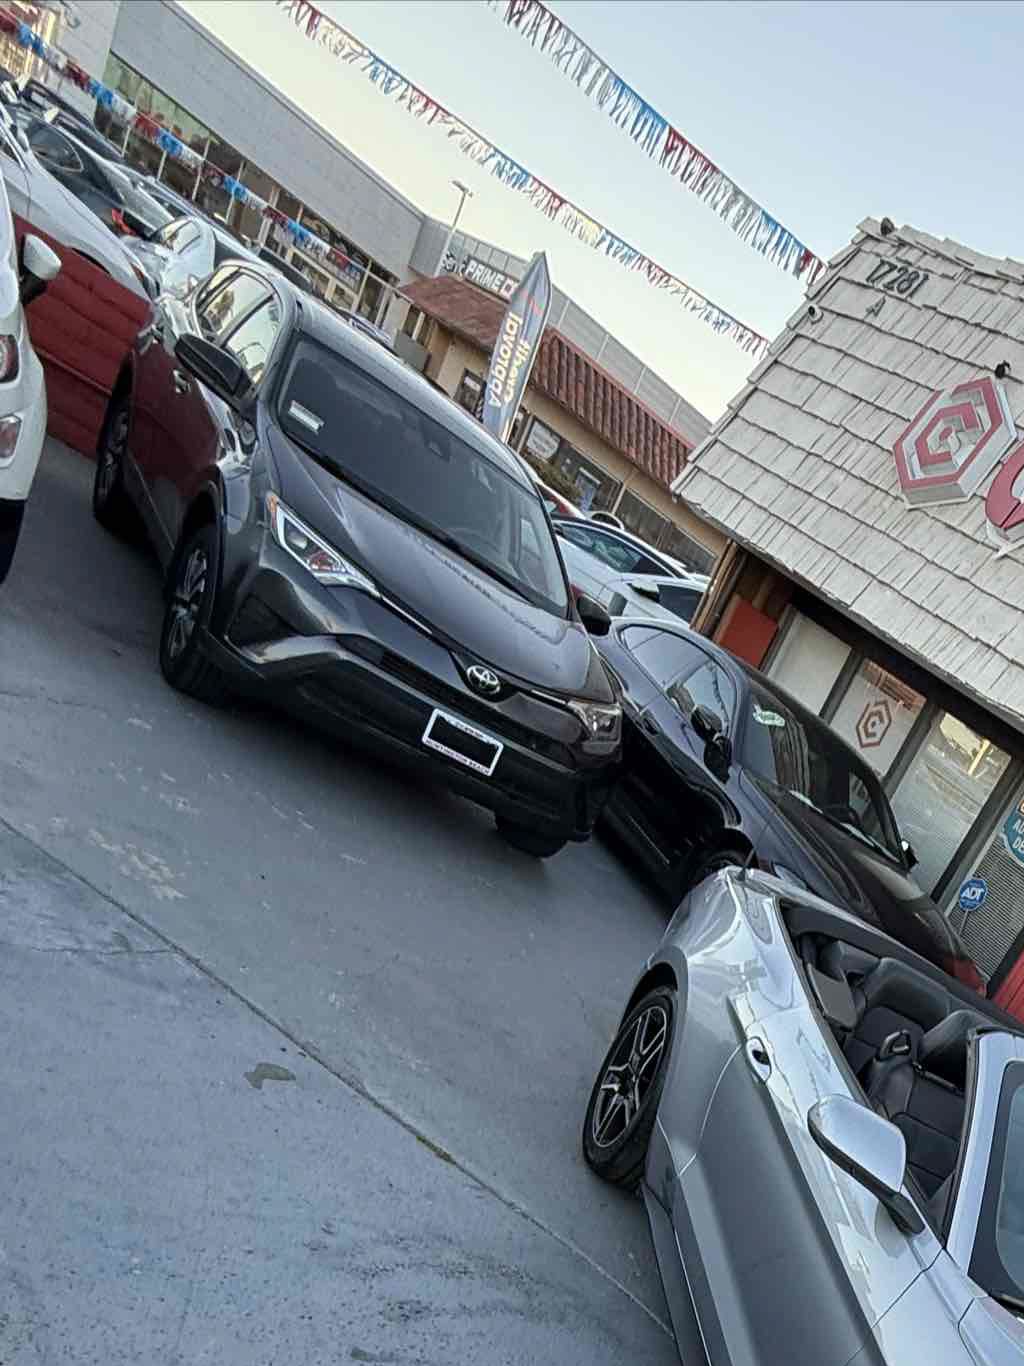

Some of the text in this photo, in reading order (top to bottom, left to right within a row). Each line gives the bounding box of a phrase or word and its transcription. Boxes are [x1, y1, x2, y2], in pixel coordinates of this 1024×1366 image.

[465, 258, 504, 293] PRIME
[866, 259, 930, 300] 17281
[960, 886, 984, 903] ADT
